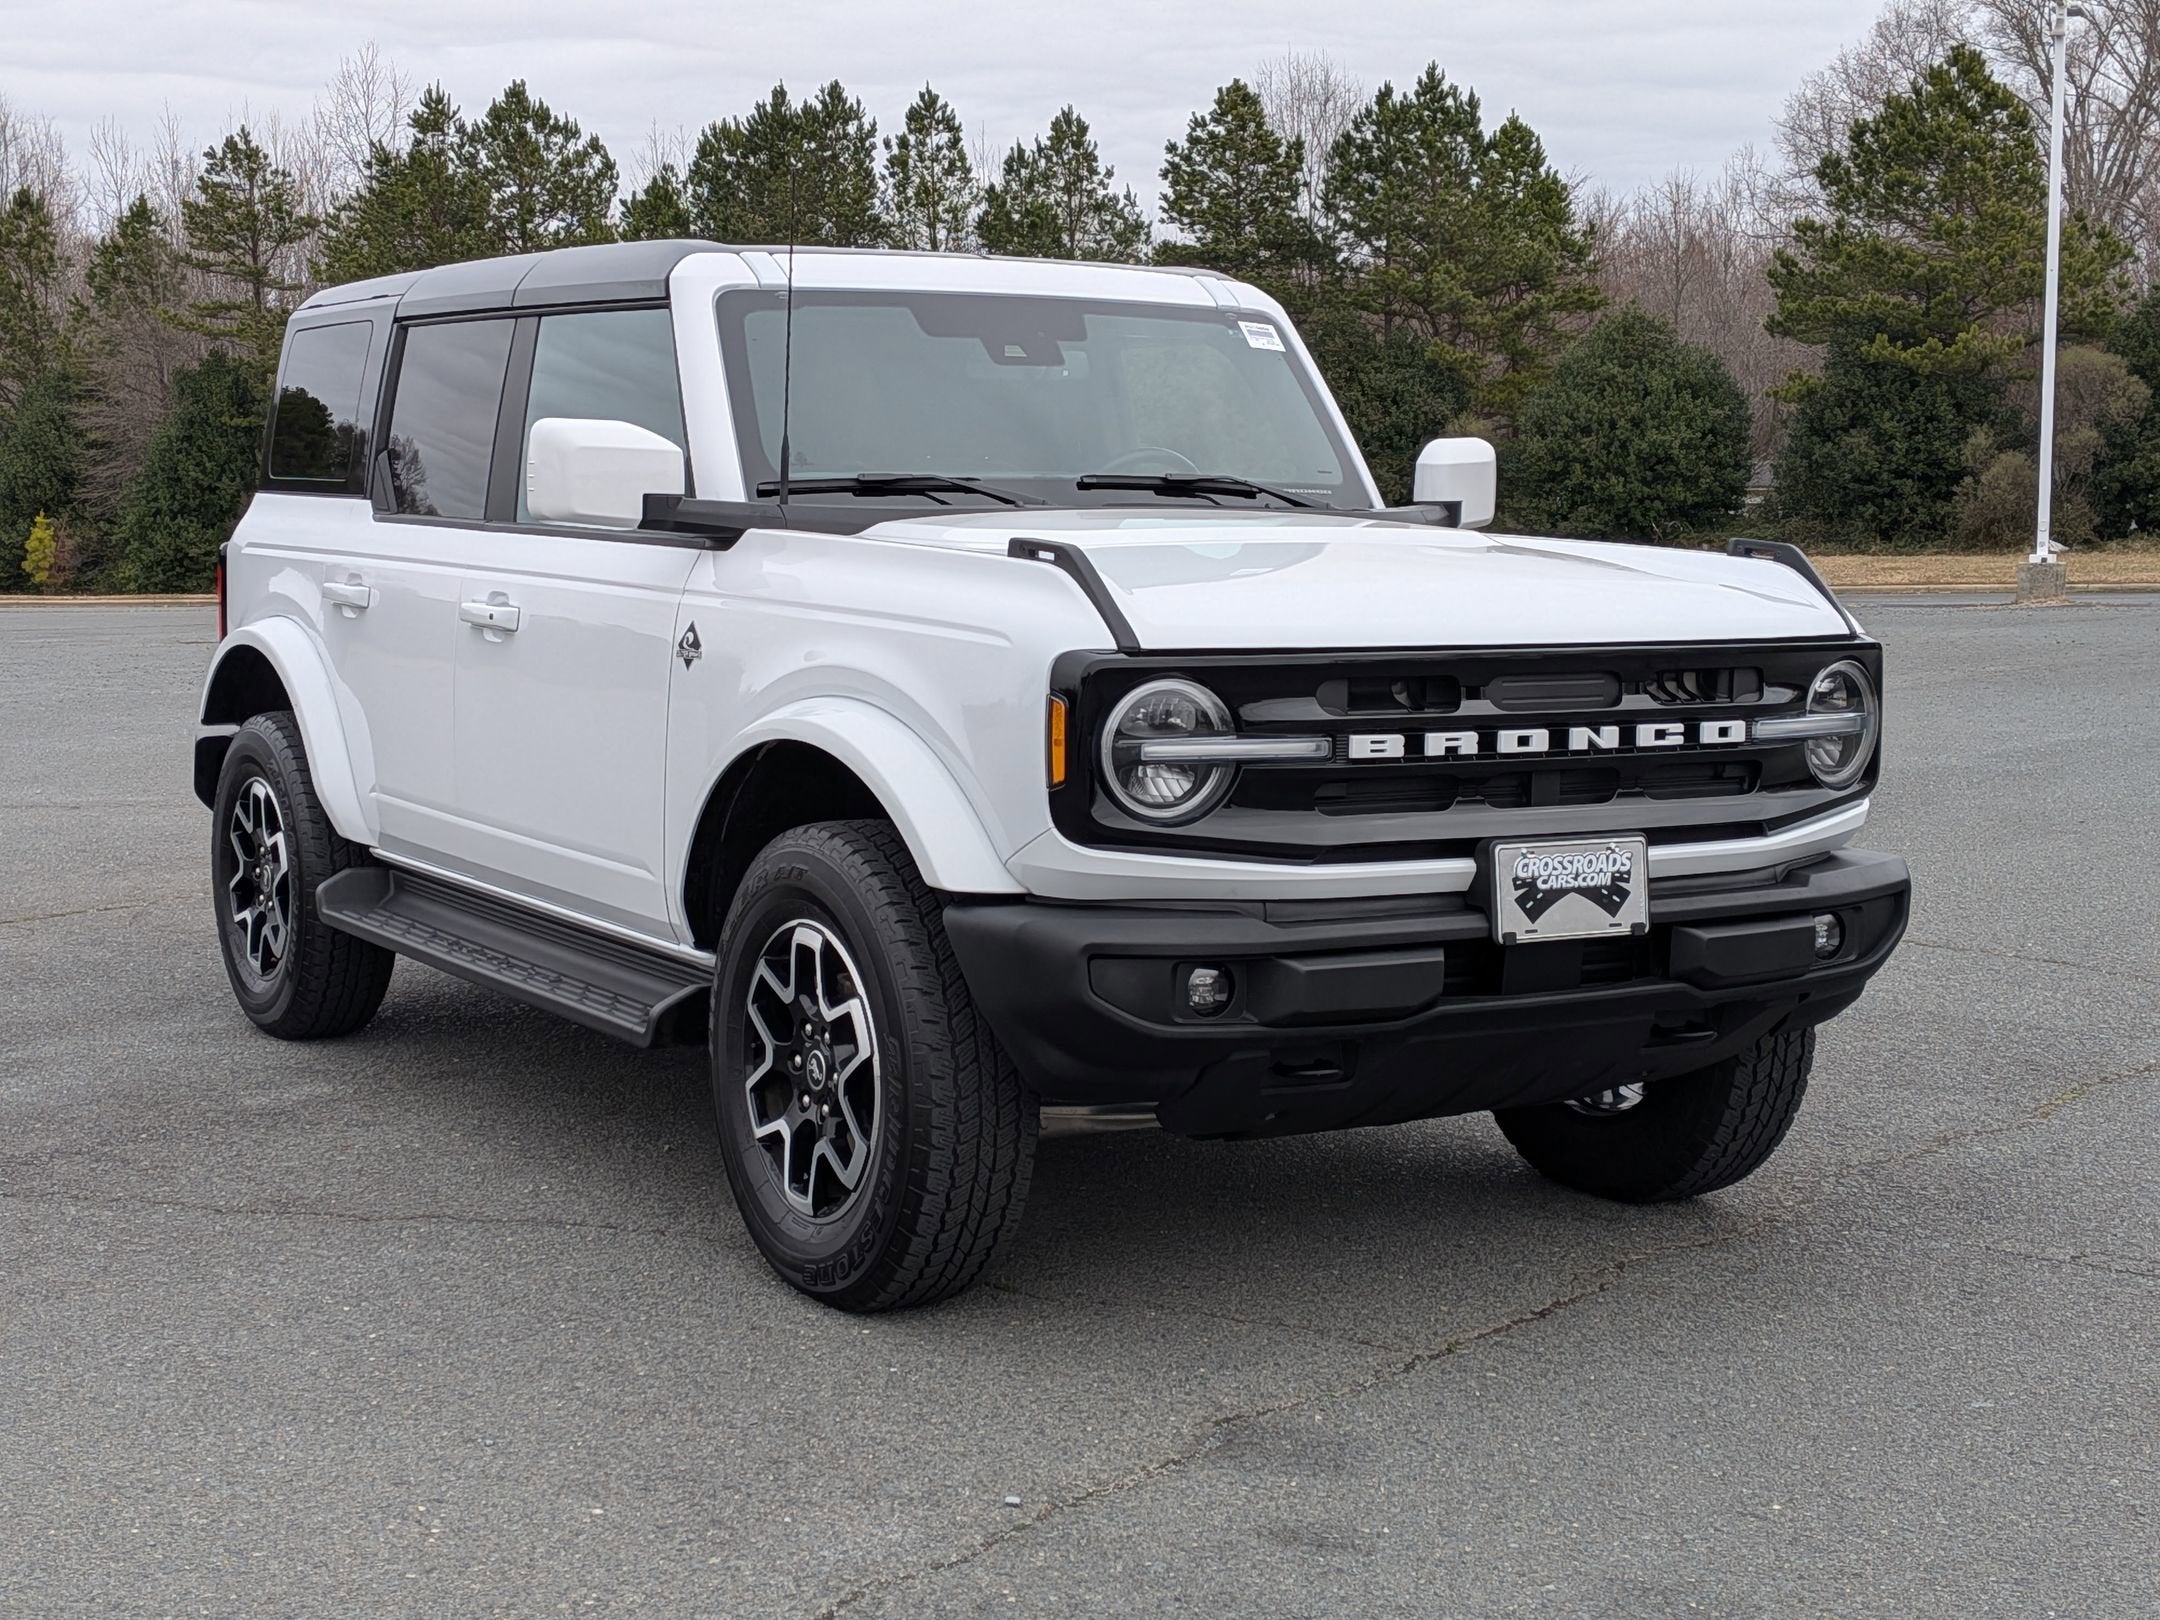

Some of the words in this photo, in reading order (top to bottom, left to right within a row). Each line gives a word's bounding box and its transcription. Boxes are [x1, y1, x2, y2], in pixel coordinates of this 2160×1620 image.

[1349, 720, 1746, 759] BRONCO
[1516, 851, 1632, 878] CROSSROADS
[1536, 872, 1612, 890] CARS.COM
